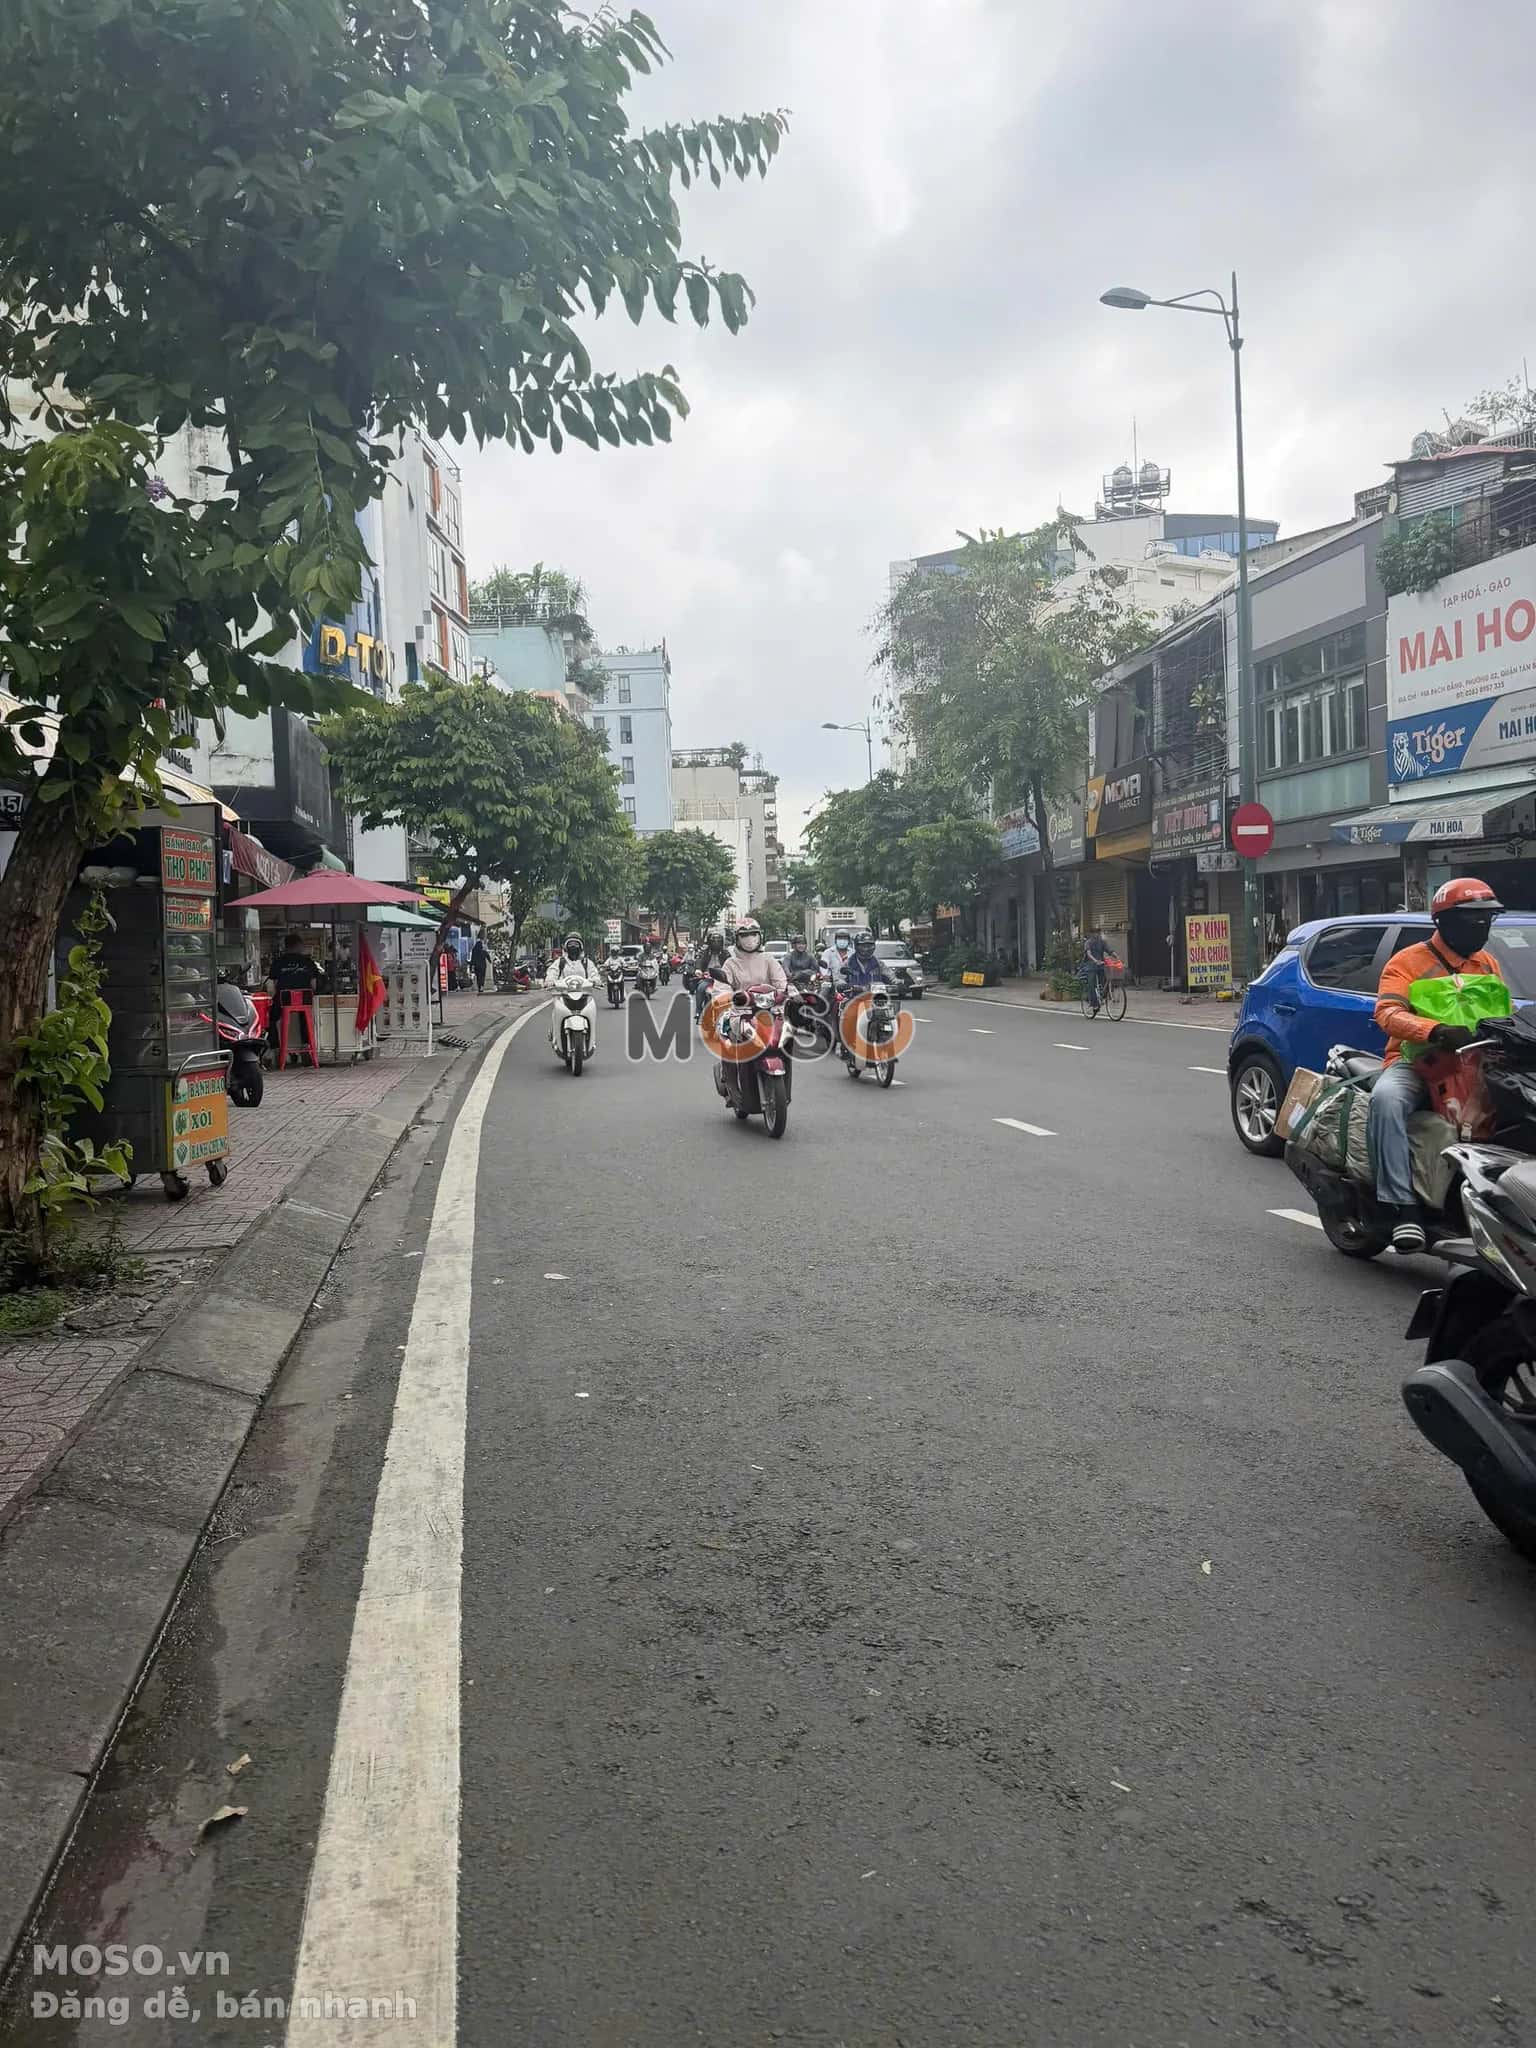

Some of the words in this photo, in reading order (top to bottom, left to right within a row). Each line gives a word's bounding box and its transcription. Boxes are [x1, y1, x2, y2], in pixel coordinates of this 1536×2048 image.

[1400, 619, 1463, 674] MAI
[1499, 719, 1522, 740] MAI
[1412, 722, 1466, 763] Tiger
[1359, 825, 1383, 842] Tiger
[1430, 821, 1445, 835] MAI
[1446, 820, 1463, 834] HOA
[165, 834, 185, 850] BÁNH
[185, 838, 200, 852] BAO
[190, 1075, 209, 1098] BÁNH
[210, 1076, 225, 1094] BAO
[191, 1107, 212, 1130] XÔI
